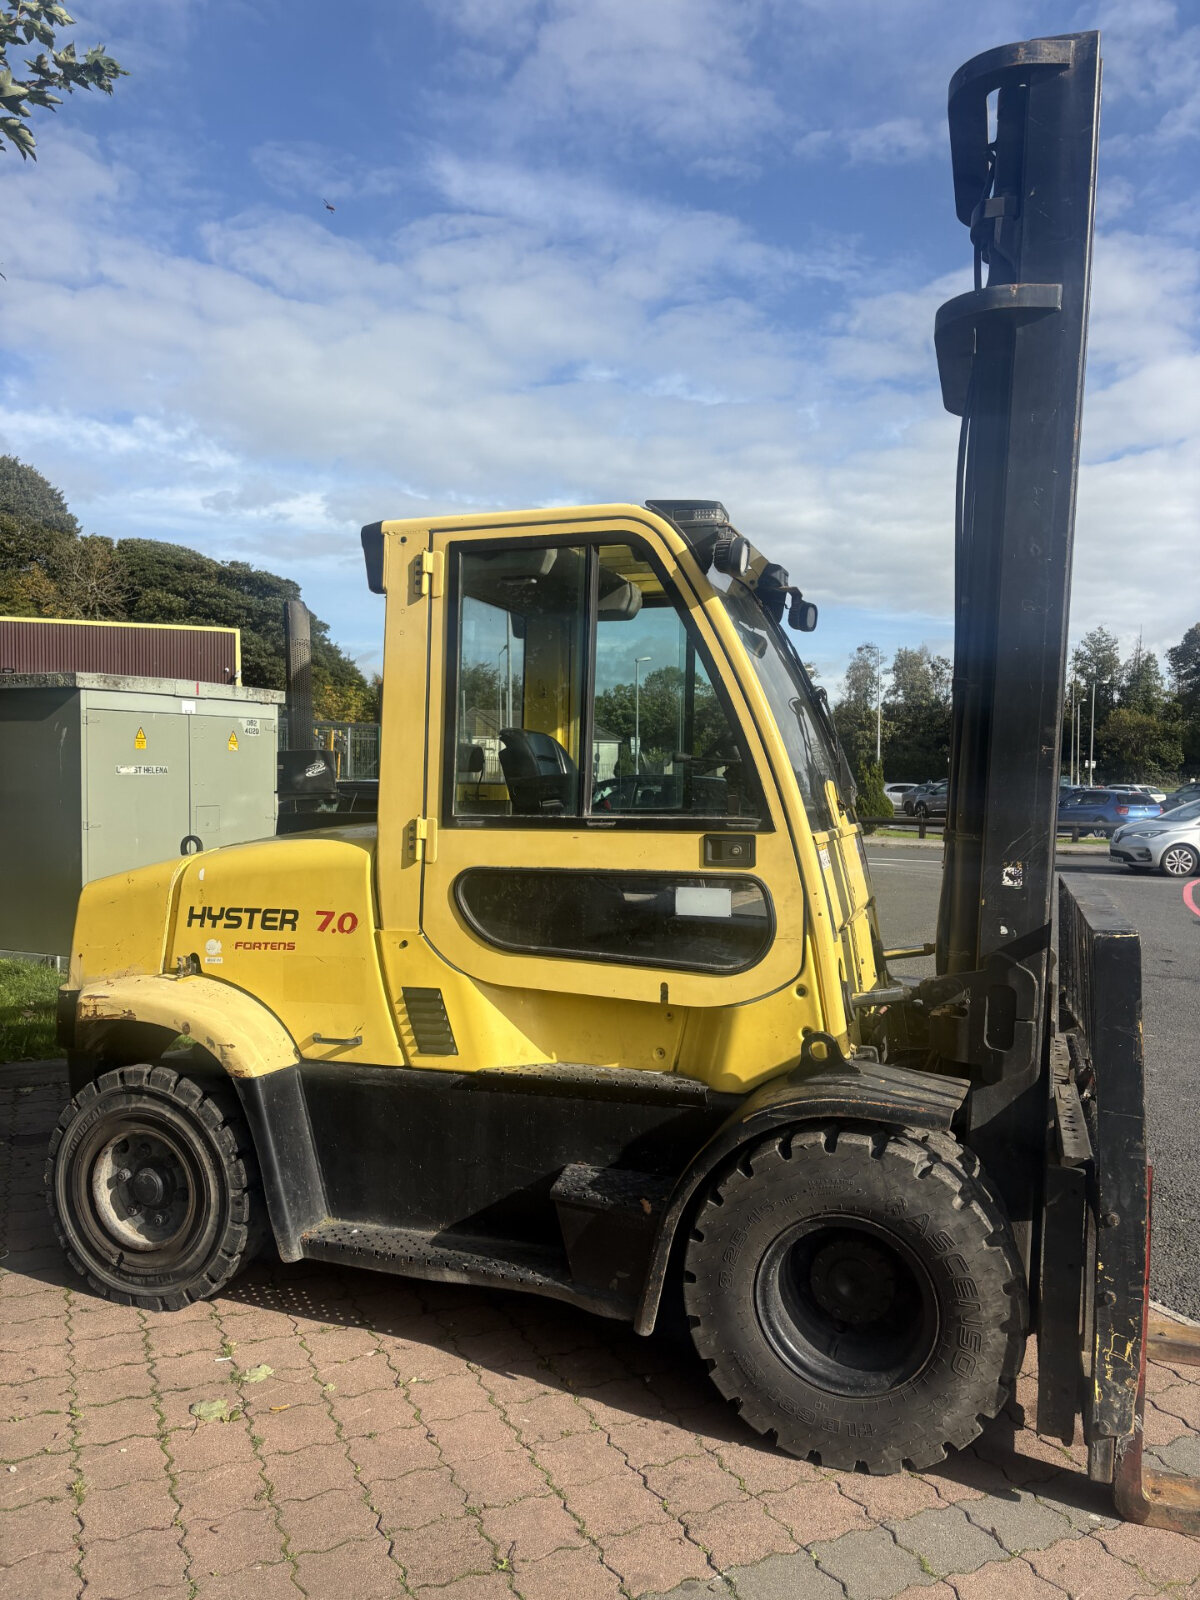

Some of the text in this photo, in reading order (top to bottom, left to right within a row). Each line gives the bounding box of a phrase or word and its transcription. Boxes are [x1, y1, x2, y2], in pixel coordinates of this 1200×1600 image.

[244, 727, 260, 735] 4020
[143, 765, 168, 774] HELENA
[187, 906, 359, 935] HYSTER 7.0
[234, 941, 296, 951] FORTENS
[904, 1212, 983, 1379] ASCENSO
